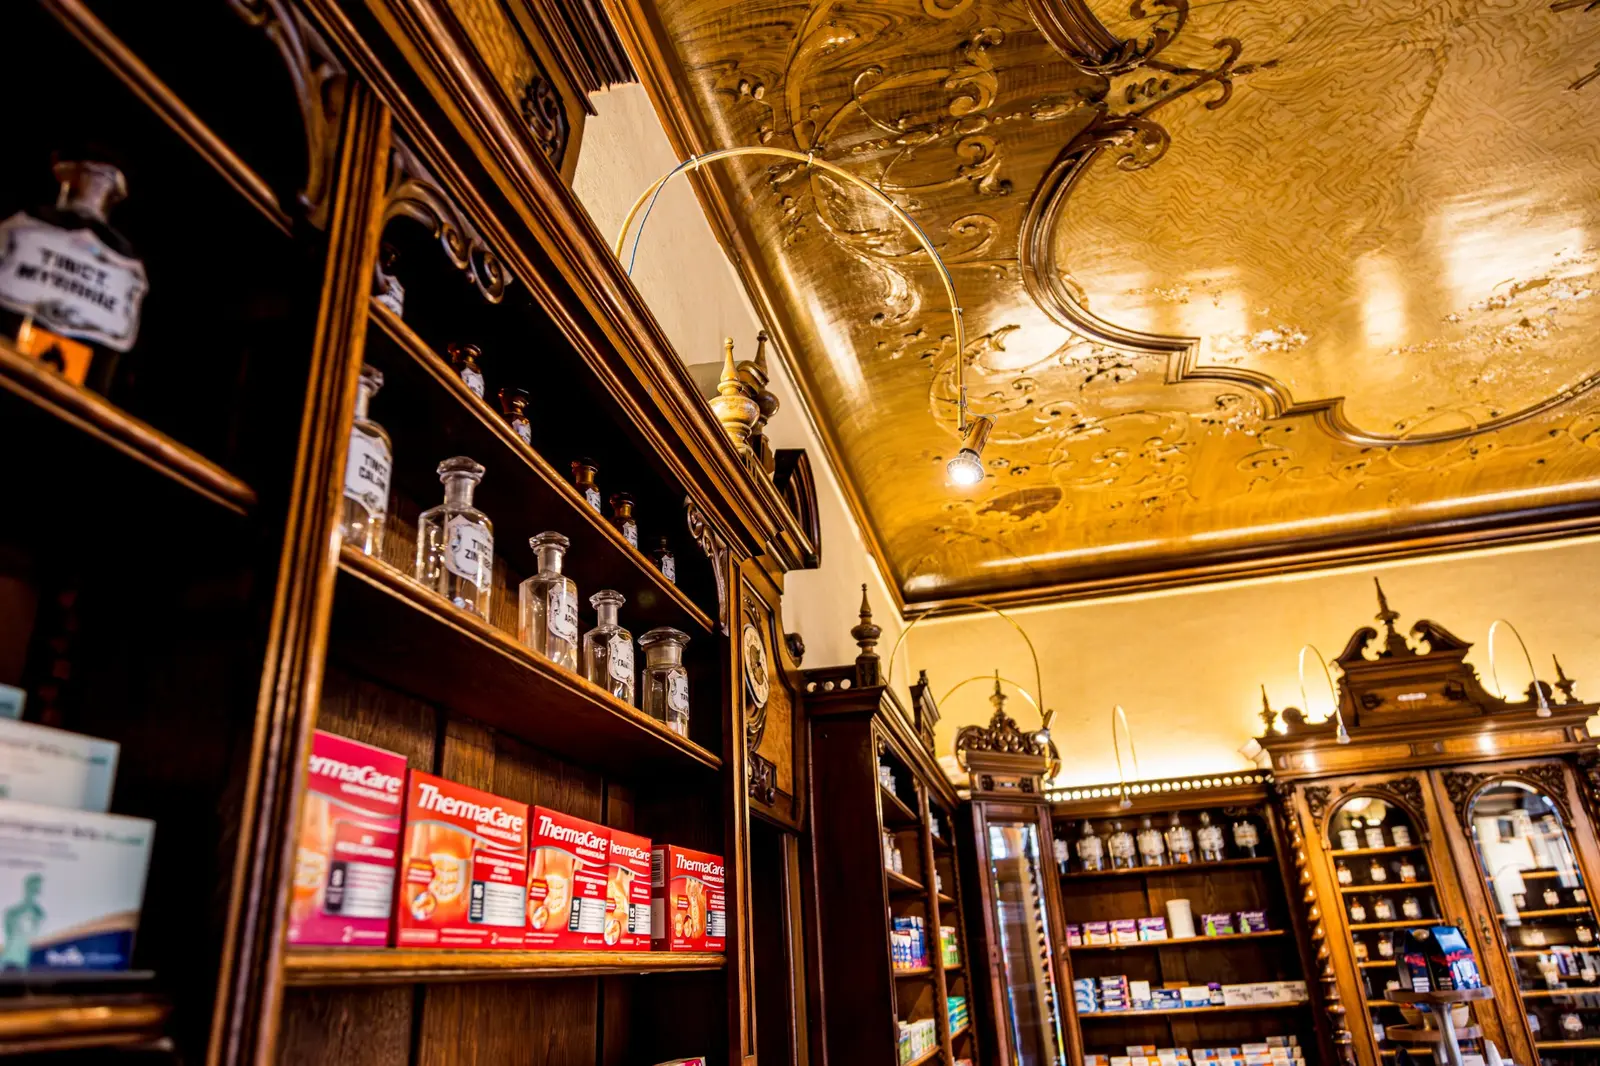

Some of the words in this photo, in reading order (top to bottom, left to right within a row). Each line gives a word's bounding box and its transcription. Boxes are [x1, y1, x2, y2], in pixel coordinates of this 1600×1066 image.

[418, 782, 524, 832] ThermaCare
[538, 815, 607, 851] ThermaCare
[610, 840, 650, 861] hermaCare
[676, 853, 724, 876] ThermaCare
